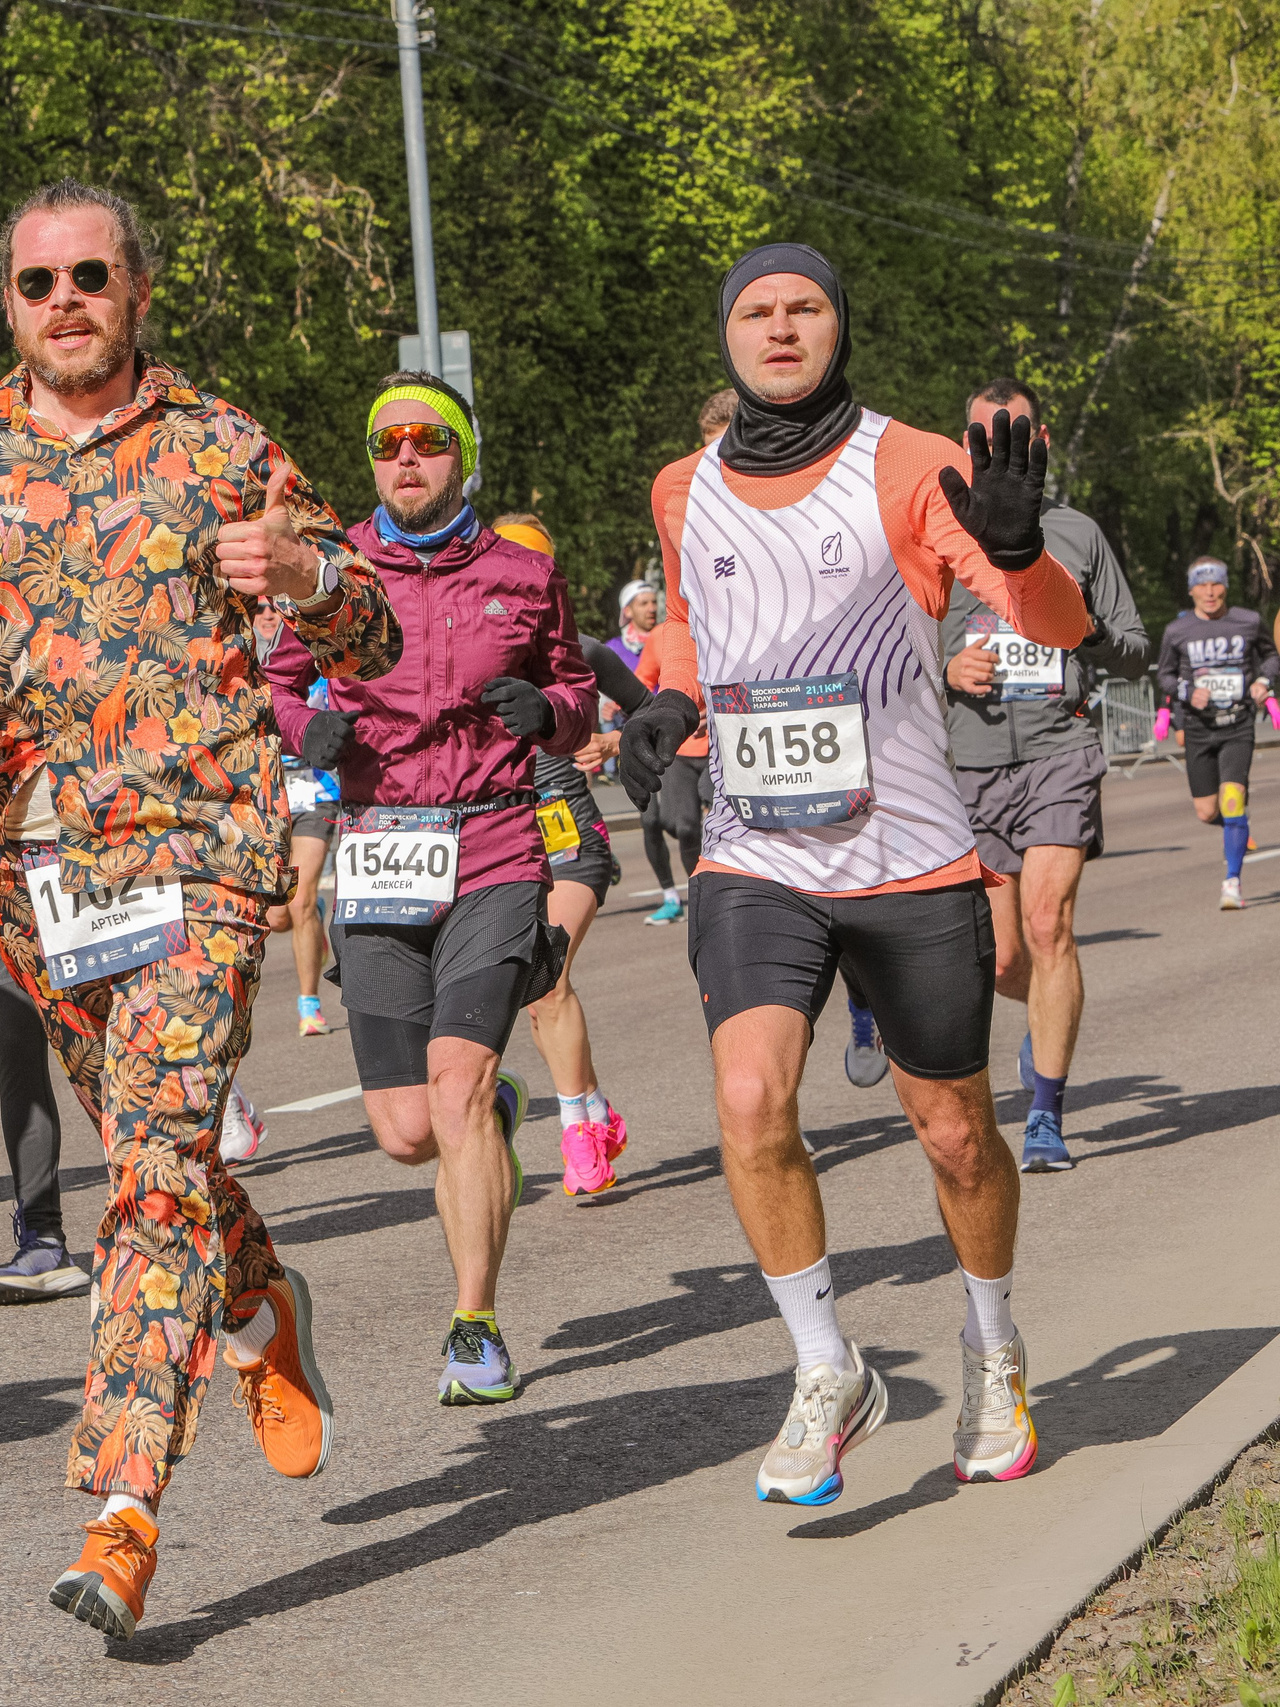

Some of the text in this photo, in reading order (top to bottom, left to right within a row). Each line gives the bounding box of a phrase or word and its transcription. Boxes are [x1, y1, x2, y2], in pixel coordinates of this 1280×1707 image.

[994, 669, 1040, 677] ОНСТАНТИН
[751, 685, 800, 696] МОСКОВСКИЙ
[753, 701, 789, 709] МАРАФОН
[736, 721, 841, 769] 6158
[762, 772, 813, 786] КИРИЛЛ
[345, 842, 450, 878] 15440
[371, 878, 412, 890] АЛЕКСЕЙ
[90, 911, 131, 932] АРТЕМ
